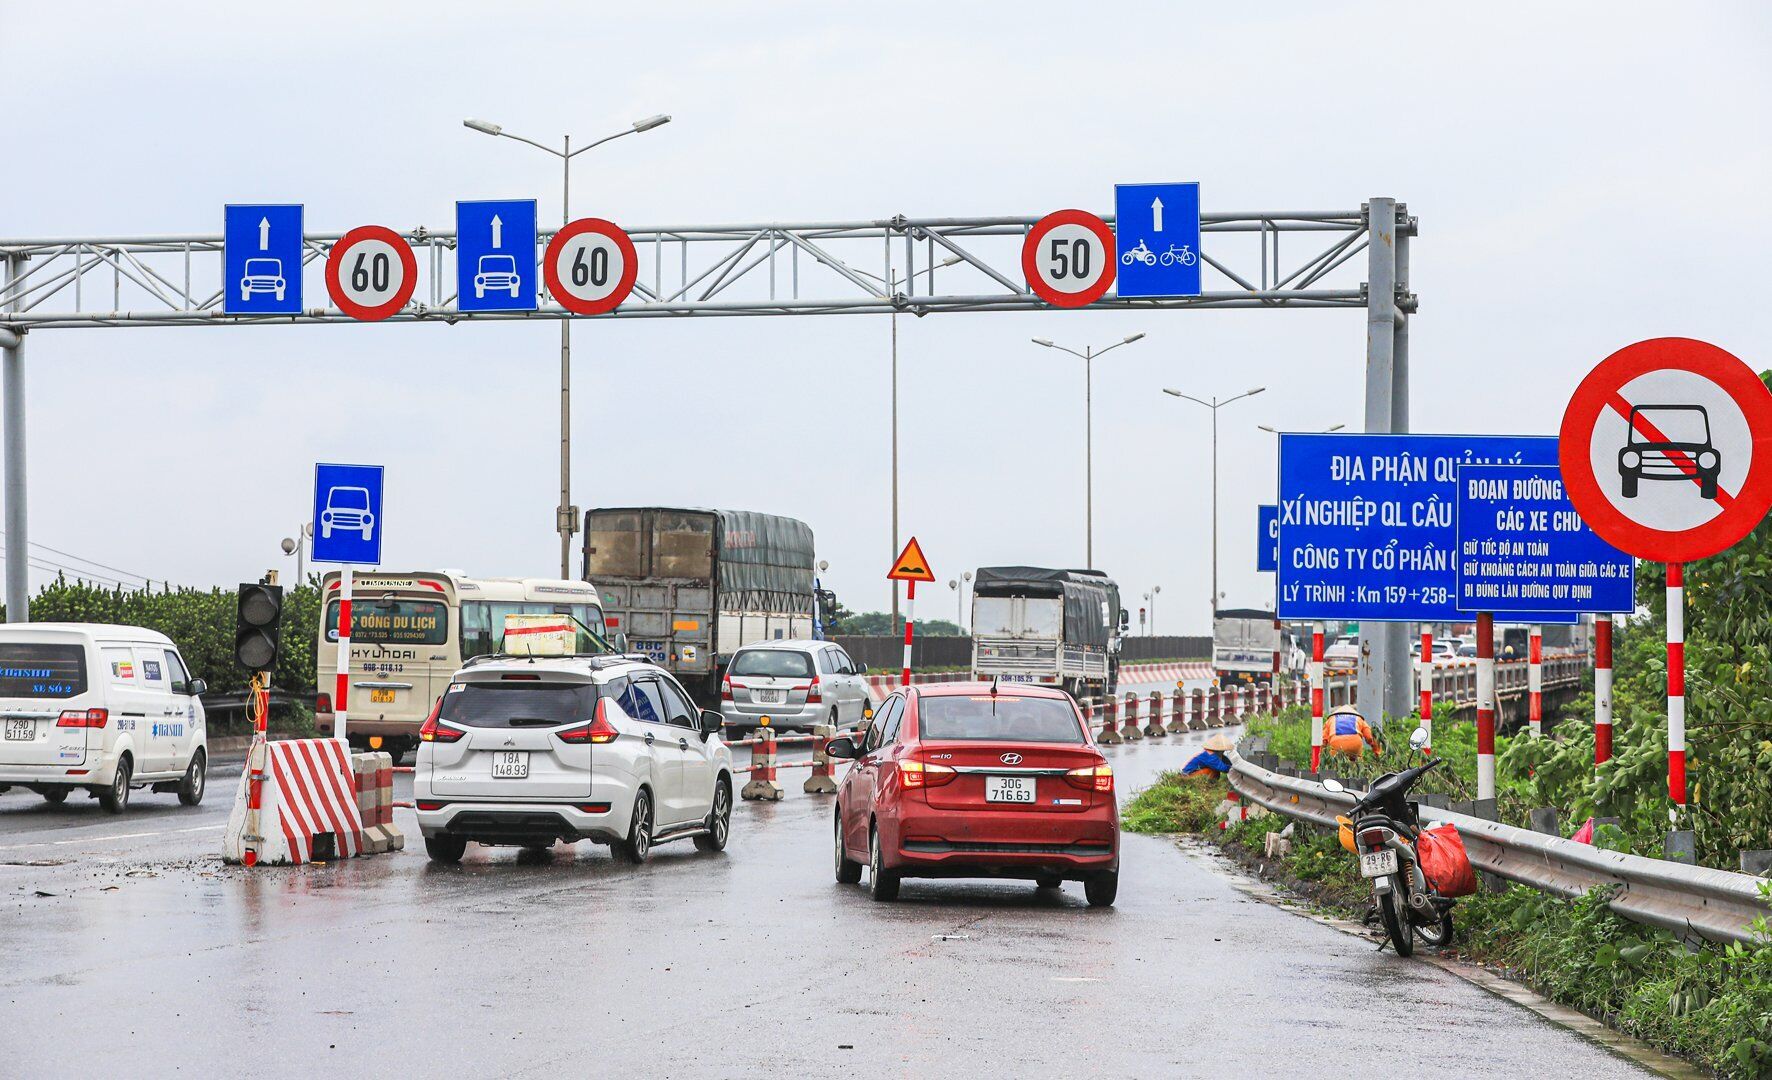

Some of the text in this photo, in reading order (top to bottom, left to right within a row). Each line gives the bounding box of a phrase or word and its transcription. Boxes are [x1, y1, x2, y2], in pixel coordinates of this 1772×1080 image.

[571, 246, 608, 287] 60
[1050, 238, 1090, 280] 50
[351, 252, 389, 292] 60
[1330, 455, 1365, 485] ĐỊA
[1371, 452, 1427, 486] PHẬN
[1468, 479, 1508, 504] ĐOẠN
[1513, 475, 1562, 500] ĐƯỜNG
[1282, 493, 1452, 532] XÍ NGHIỆP QL CẦU
[1496, 506, 1525, 531] CÁC
[1529, 511, 1548, 532] XE
[1293, 543, 1339, 569] CÔNG
[1345, 548, 1371, 570] TY
[1372, 538, 1398, 570] CỔ
[1400, 541, 1446, 571] PHẦN
[1463, 537, 1549, 559] GIỮ TỐC ĐỘ AN TOÀN
[1463, 559, 1478, 576] GIỮ
[1480, 557, 1515, 577] KHOẢNG
[1516, 559, 1539, 577] CÁCH
[1541, 563, 1553, 577] AN
[1555, 560, 1577, 578] TOÀN
[1578, 560, 1598, 578] GIỮA
[1600, 560, 1616, 578] CÁC
[1618, 564, 1630, 578] XE
[1283, 580, 1299, 602] LÝ
[1304, 580, 1345, 602] TRÌNH
[1465, 580, 1592, 603] ĐI ĐÚNG LÀN ĐƯỜNG QUY ĐỊNH
[394, 616, 409, 629] DU
[411, 616, 436, 632] LỊCH
[351, 649, 416, 659] HYUNDAI
[636, 641, 663, 651] 88C
[363, 663, 403, 672] 99B-018.13
[65, 685, 72, 693] 2
[13, 720, 29, 729] 29D
[158, 722, 183, 736] nasun
[503, 752, 520, 764] 18A
[495, 765, 527, 776] 148.93
[1000, 778, 1022, 789] 30G
[991, 790, 1031, 801] 716.63
